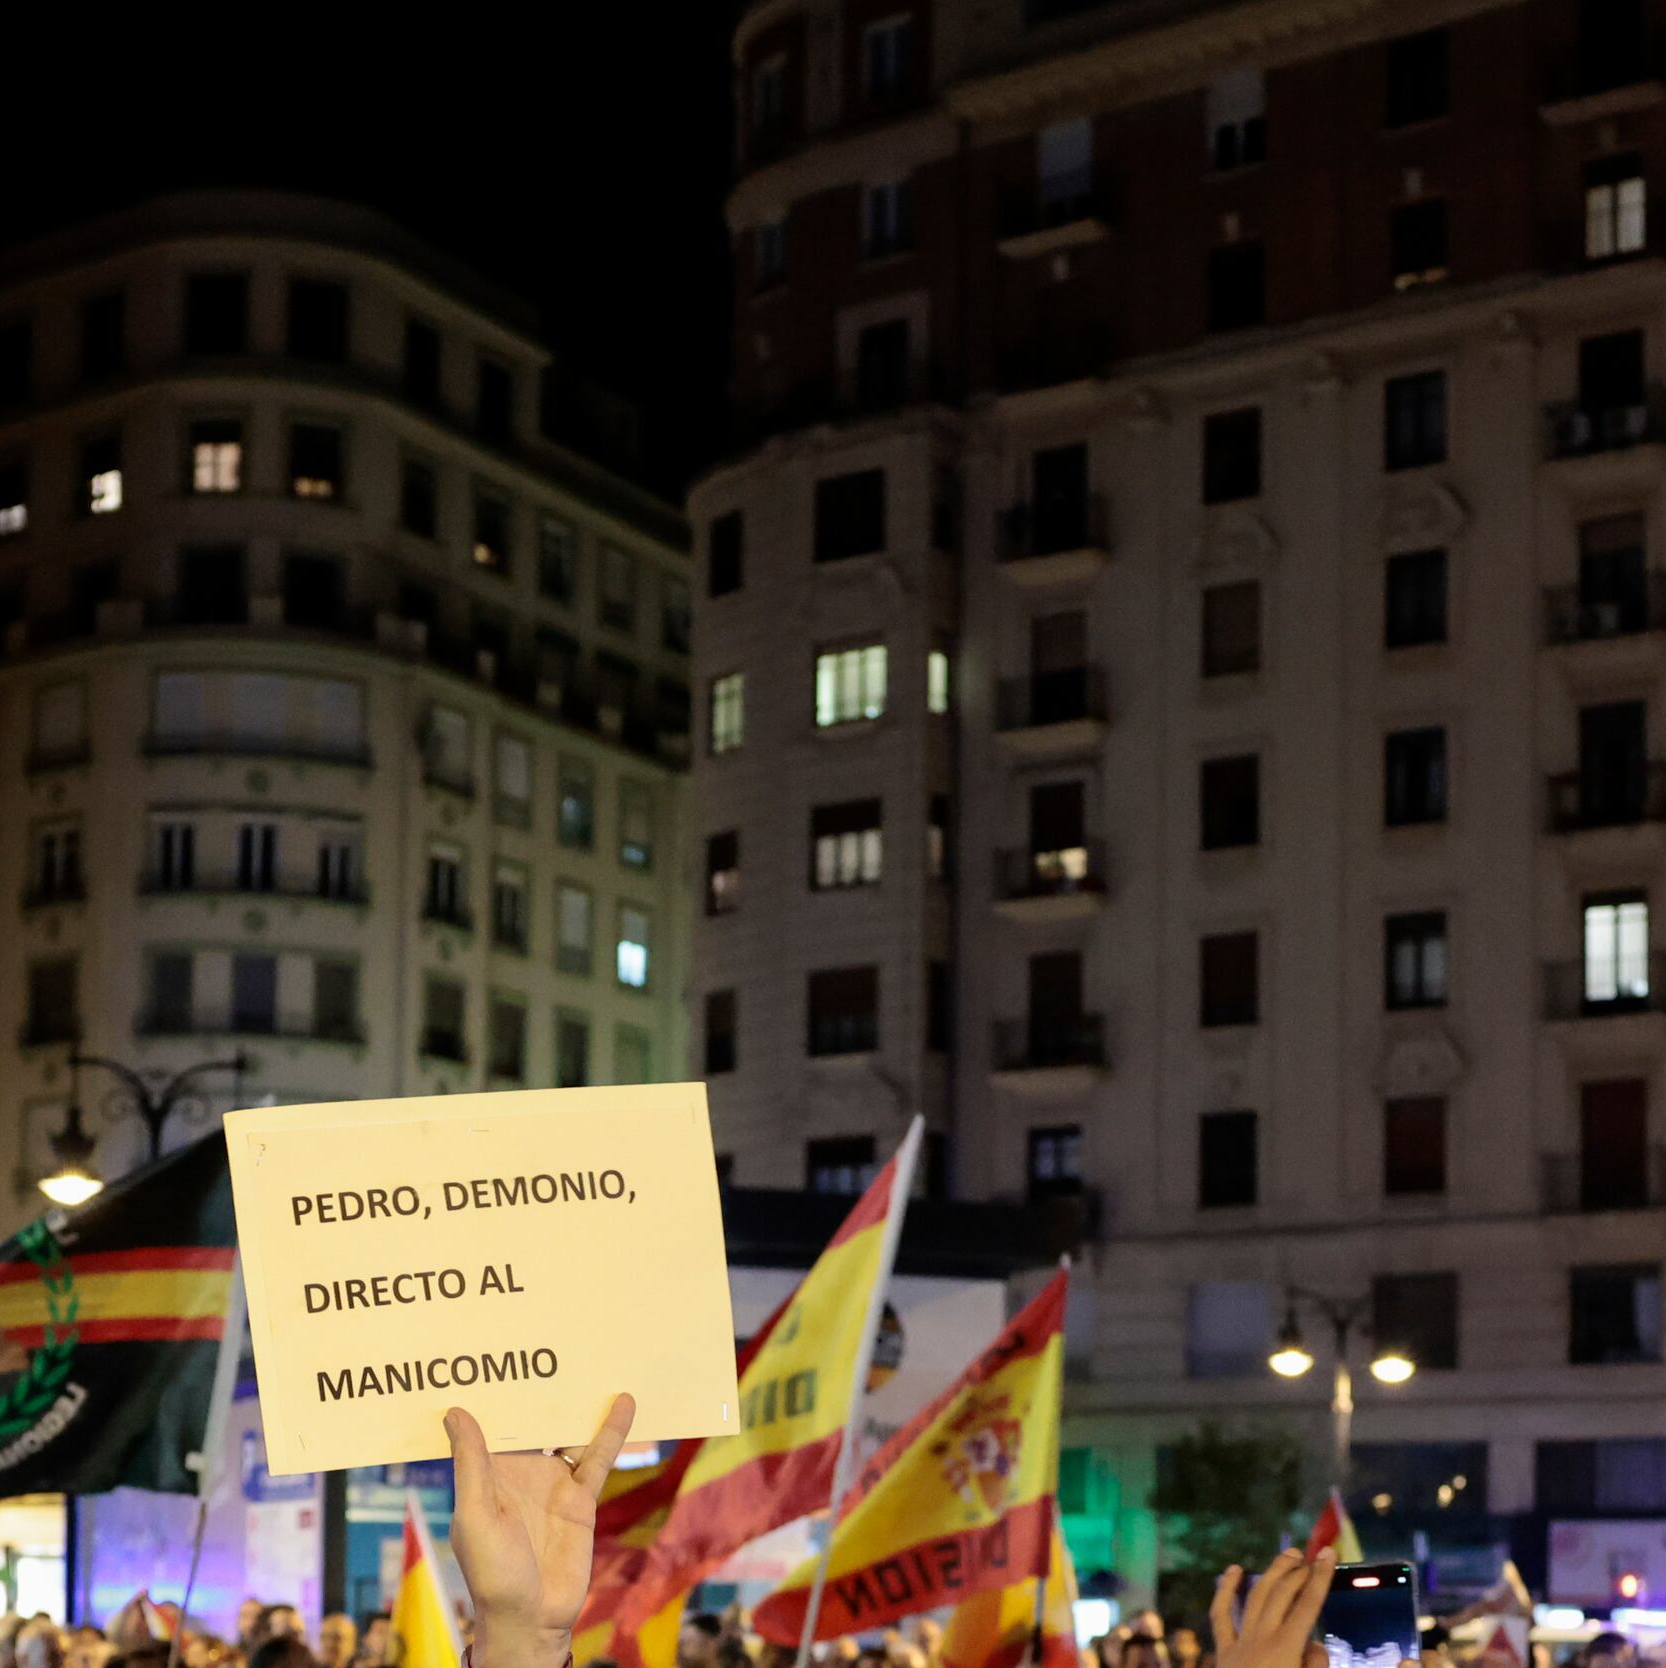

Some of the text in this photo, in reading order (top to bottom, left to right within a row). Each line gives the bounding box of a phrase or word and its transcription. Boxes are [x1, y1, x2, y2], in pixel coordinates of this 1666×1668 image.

[290, 1168, 637, 1227] PEDRO, DEMONIO,
[303, 1262, 525, 1315] DIRECTO AL
[315, 1348, 559, 1403] MANICOMIO
